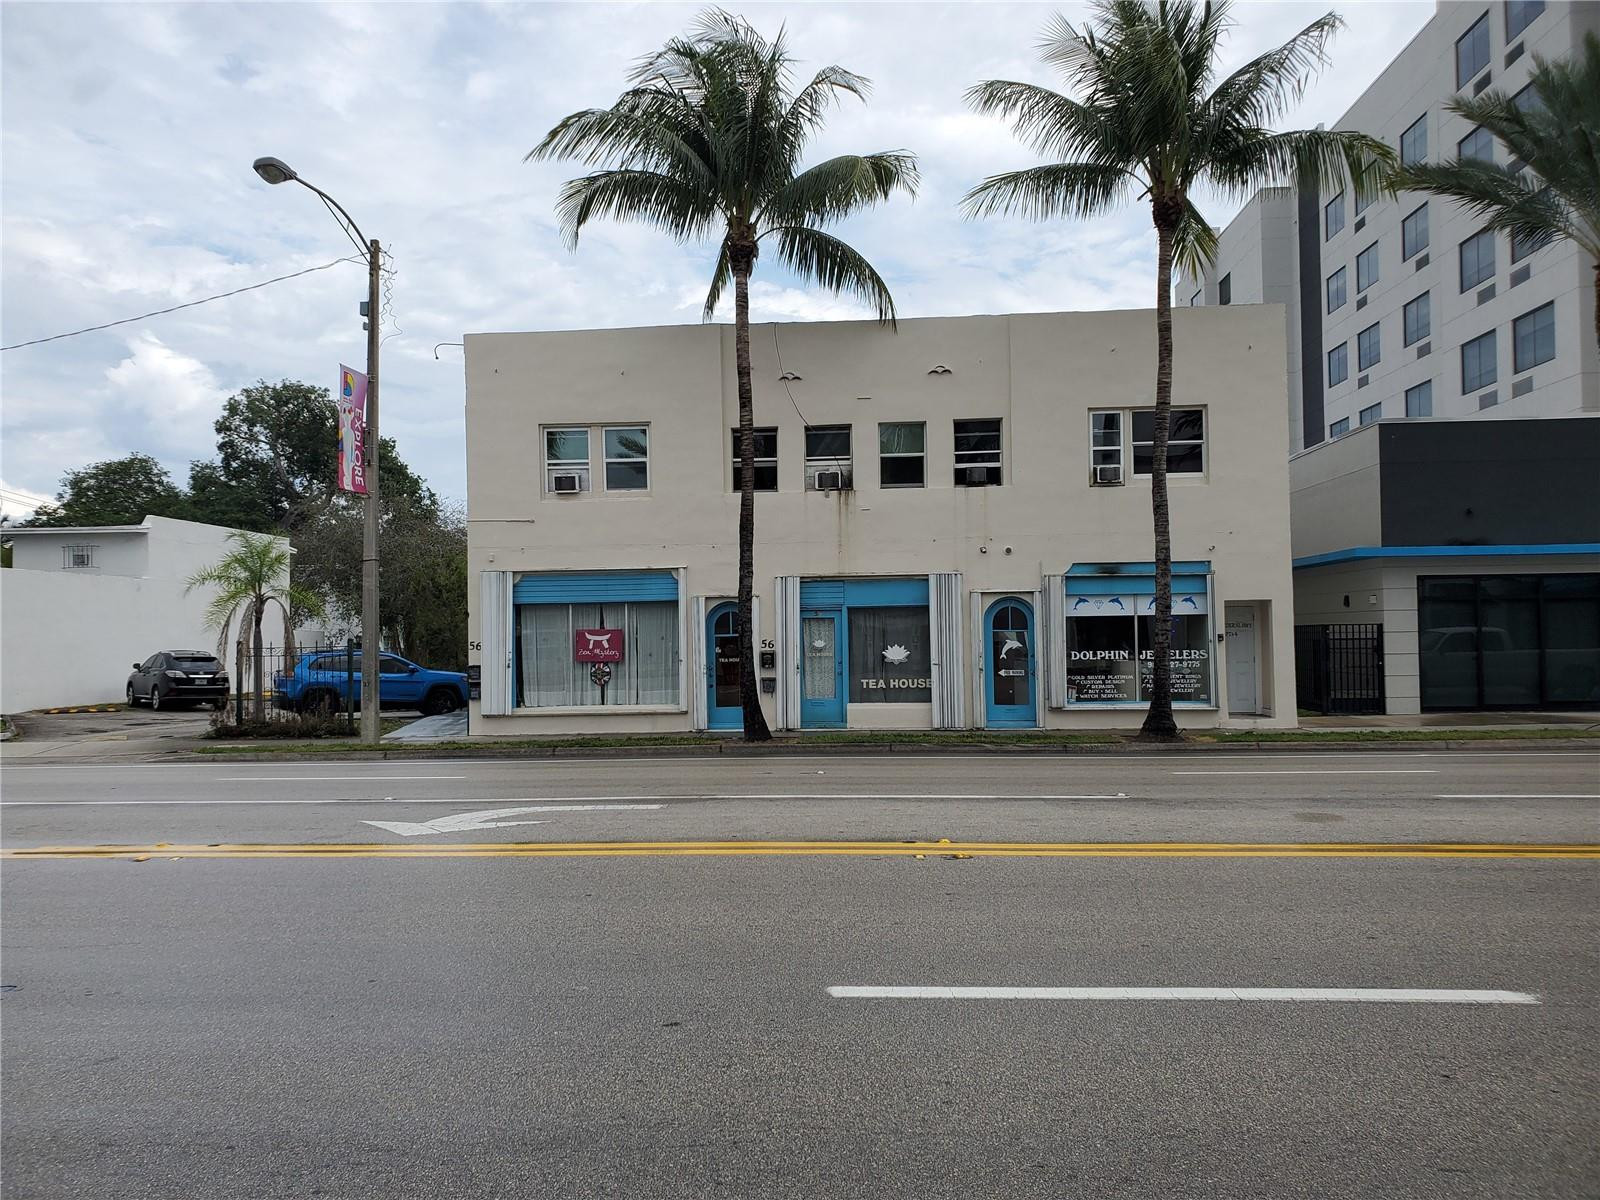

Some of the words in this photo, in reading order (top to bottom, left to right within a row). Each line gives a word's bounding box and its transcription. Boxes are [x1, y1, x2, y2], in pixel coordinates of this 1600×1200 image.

[354, 408, 364, 487] EXPLORE
[760, 639, 775, 649] 56
[1071, 650, 1129, 660] DOLPHIN
[1139, 649, 1208, 660] JEELERS
[861, 679, 886, 689] TEA
[890, 679, 936, 689] HOUSE
